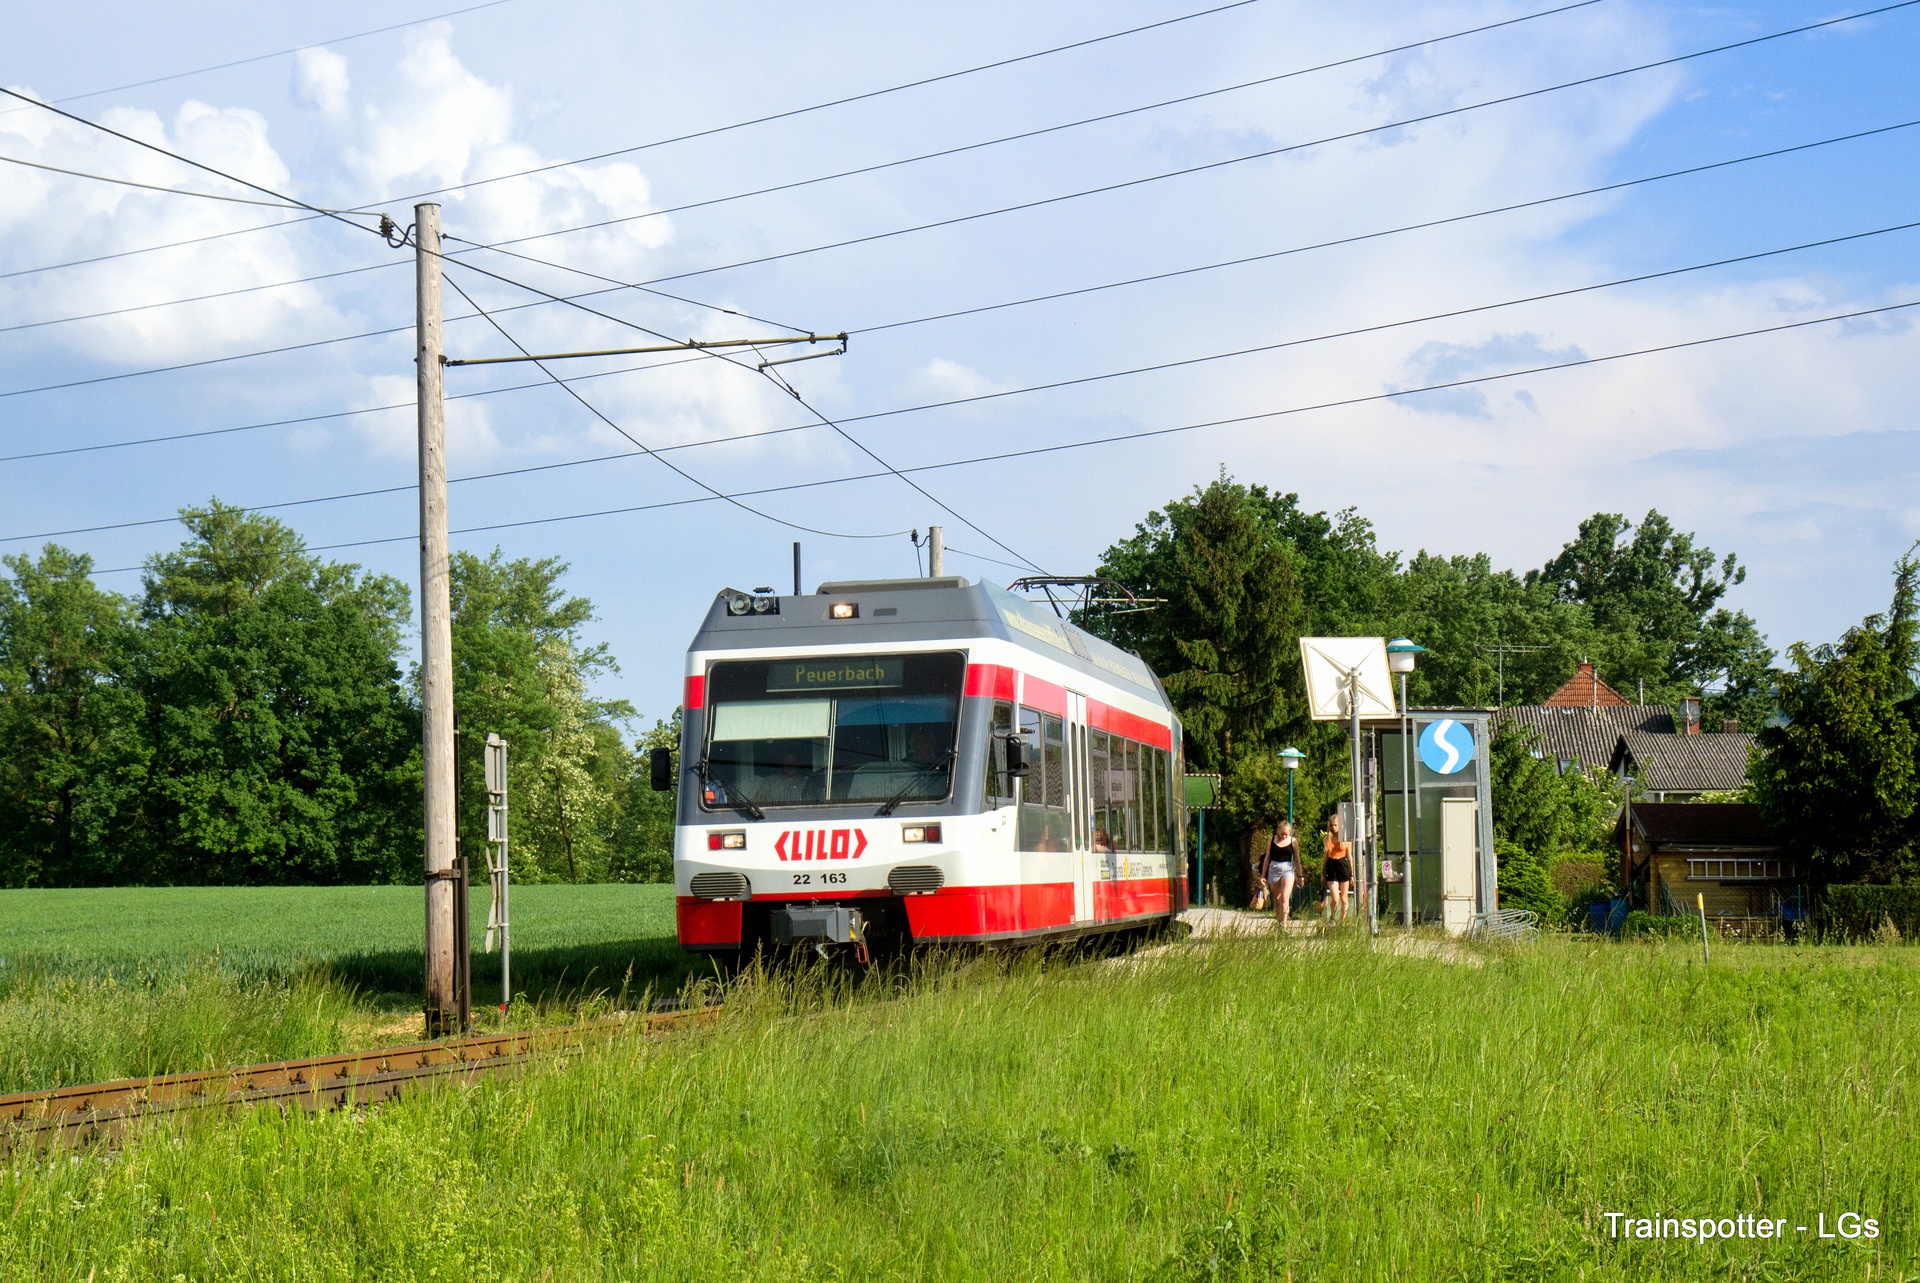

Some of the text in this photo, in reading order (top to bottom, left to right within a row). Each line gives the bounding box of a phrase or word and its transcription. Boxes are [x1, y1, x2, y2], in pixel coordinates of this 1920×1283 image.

[795, 664, 884, 682] Peuerbach
[790, 828, 851, 861] LILO
[793, 872, 847, 885] 22 163
